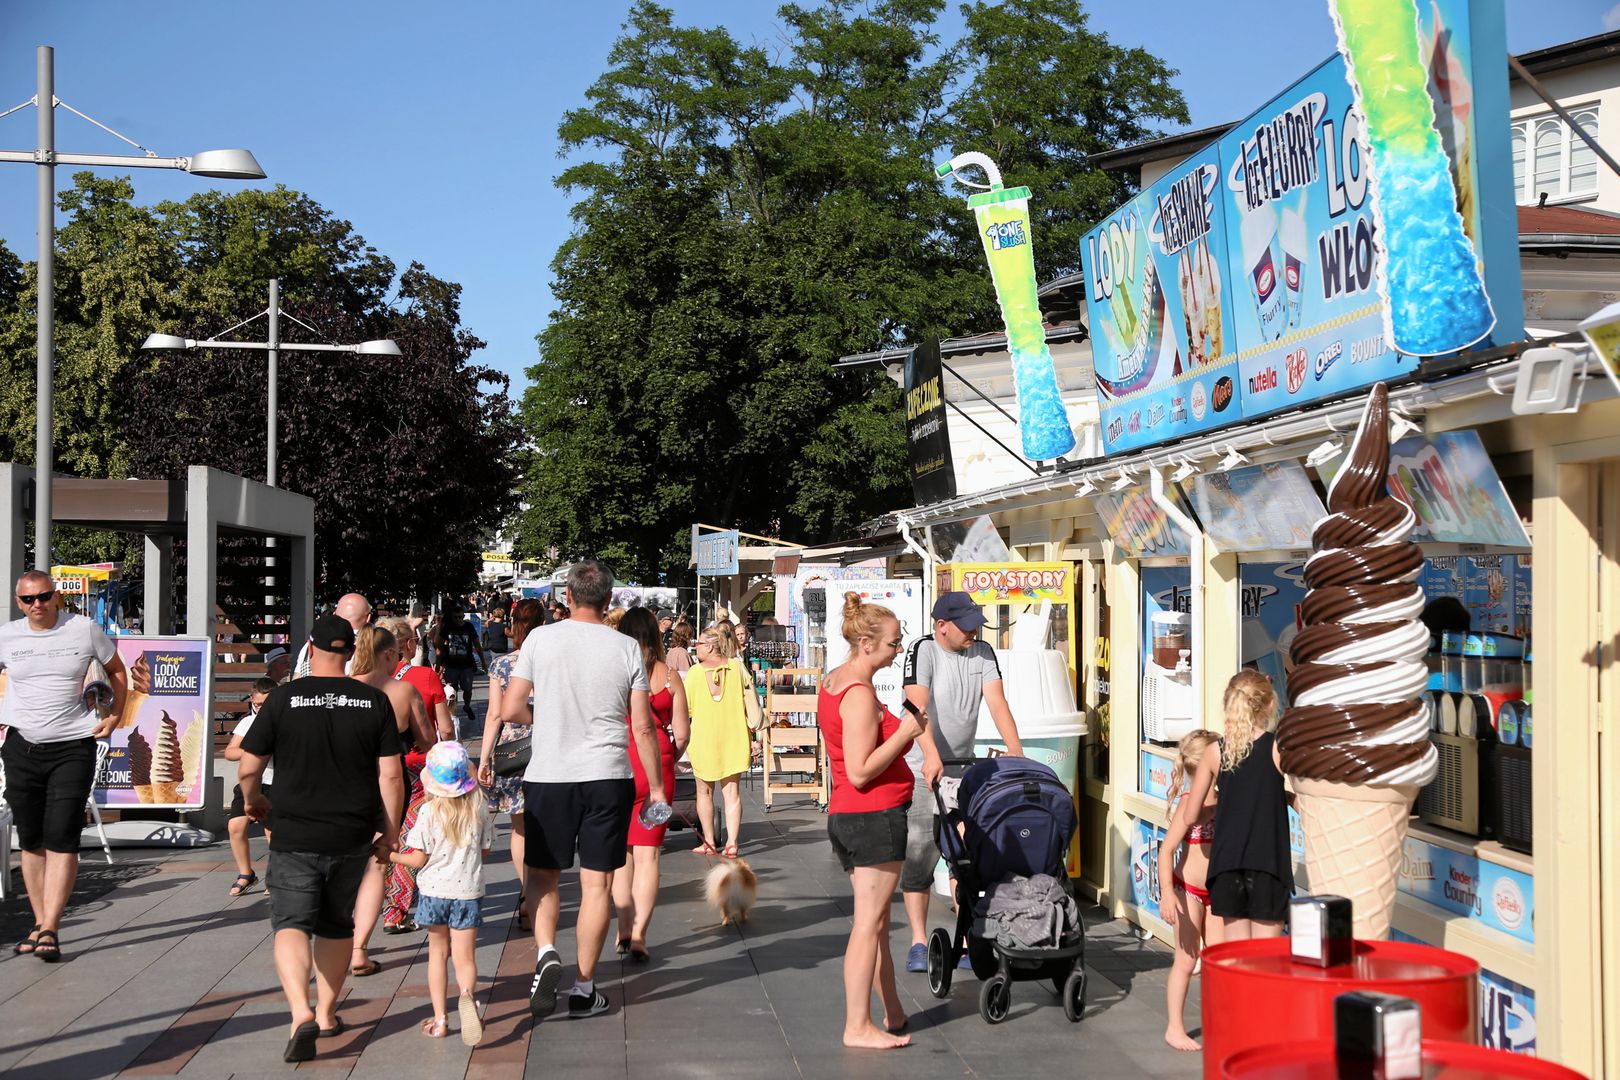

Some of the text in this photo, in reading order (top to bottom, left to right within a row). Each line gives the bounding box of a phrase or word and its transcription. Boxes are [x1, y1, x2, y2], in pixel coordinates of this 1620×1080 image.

[1321, 103, 1368, 219] LO
[998, 219, 1023, 237] ONE
[1000, 231, 1026, 248] SLUSH
[1088, 208, 1137, 304] LODY
[1319, 217, 1377, 299] WŁO
[1315, 341, 1343, 375] OREO
[1248, 367, 1278, 394] nutella
[62, 581, 81, 590] DOG
[965, 571, 1002, 589] TOY
[1006, 570, 1066, 590] STORY
[154, 664, 180, 676] LODY
[154, 676, 198, 689] WŁOSKIE
[290, 695, 372, 709] Black Seven
[1449, 864, 1473, 885] Kinder
[1444, 880, 1482, 917] Country
